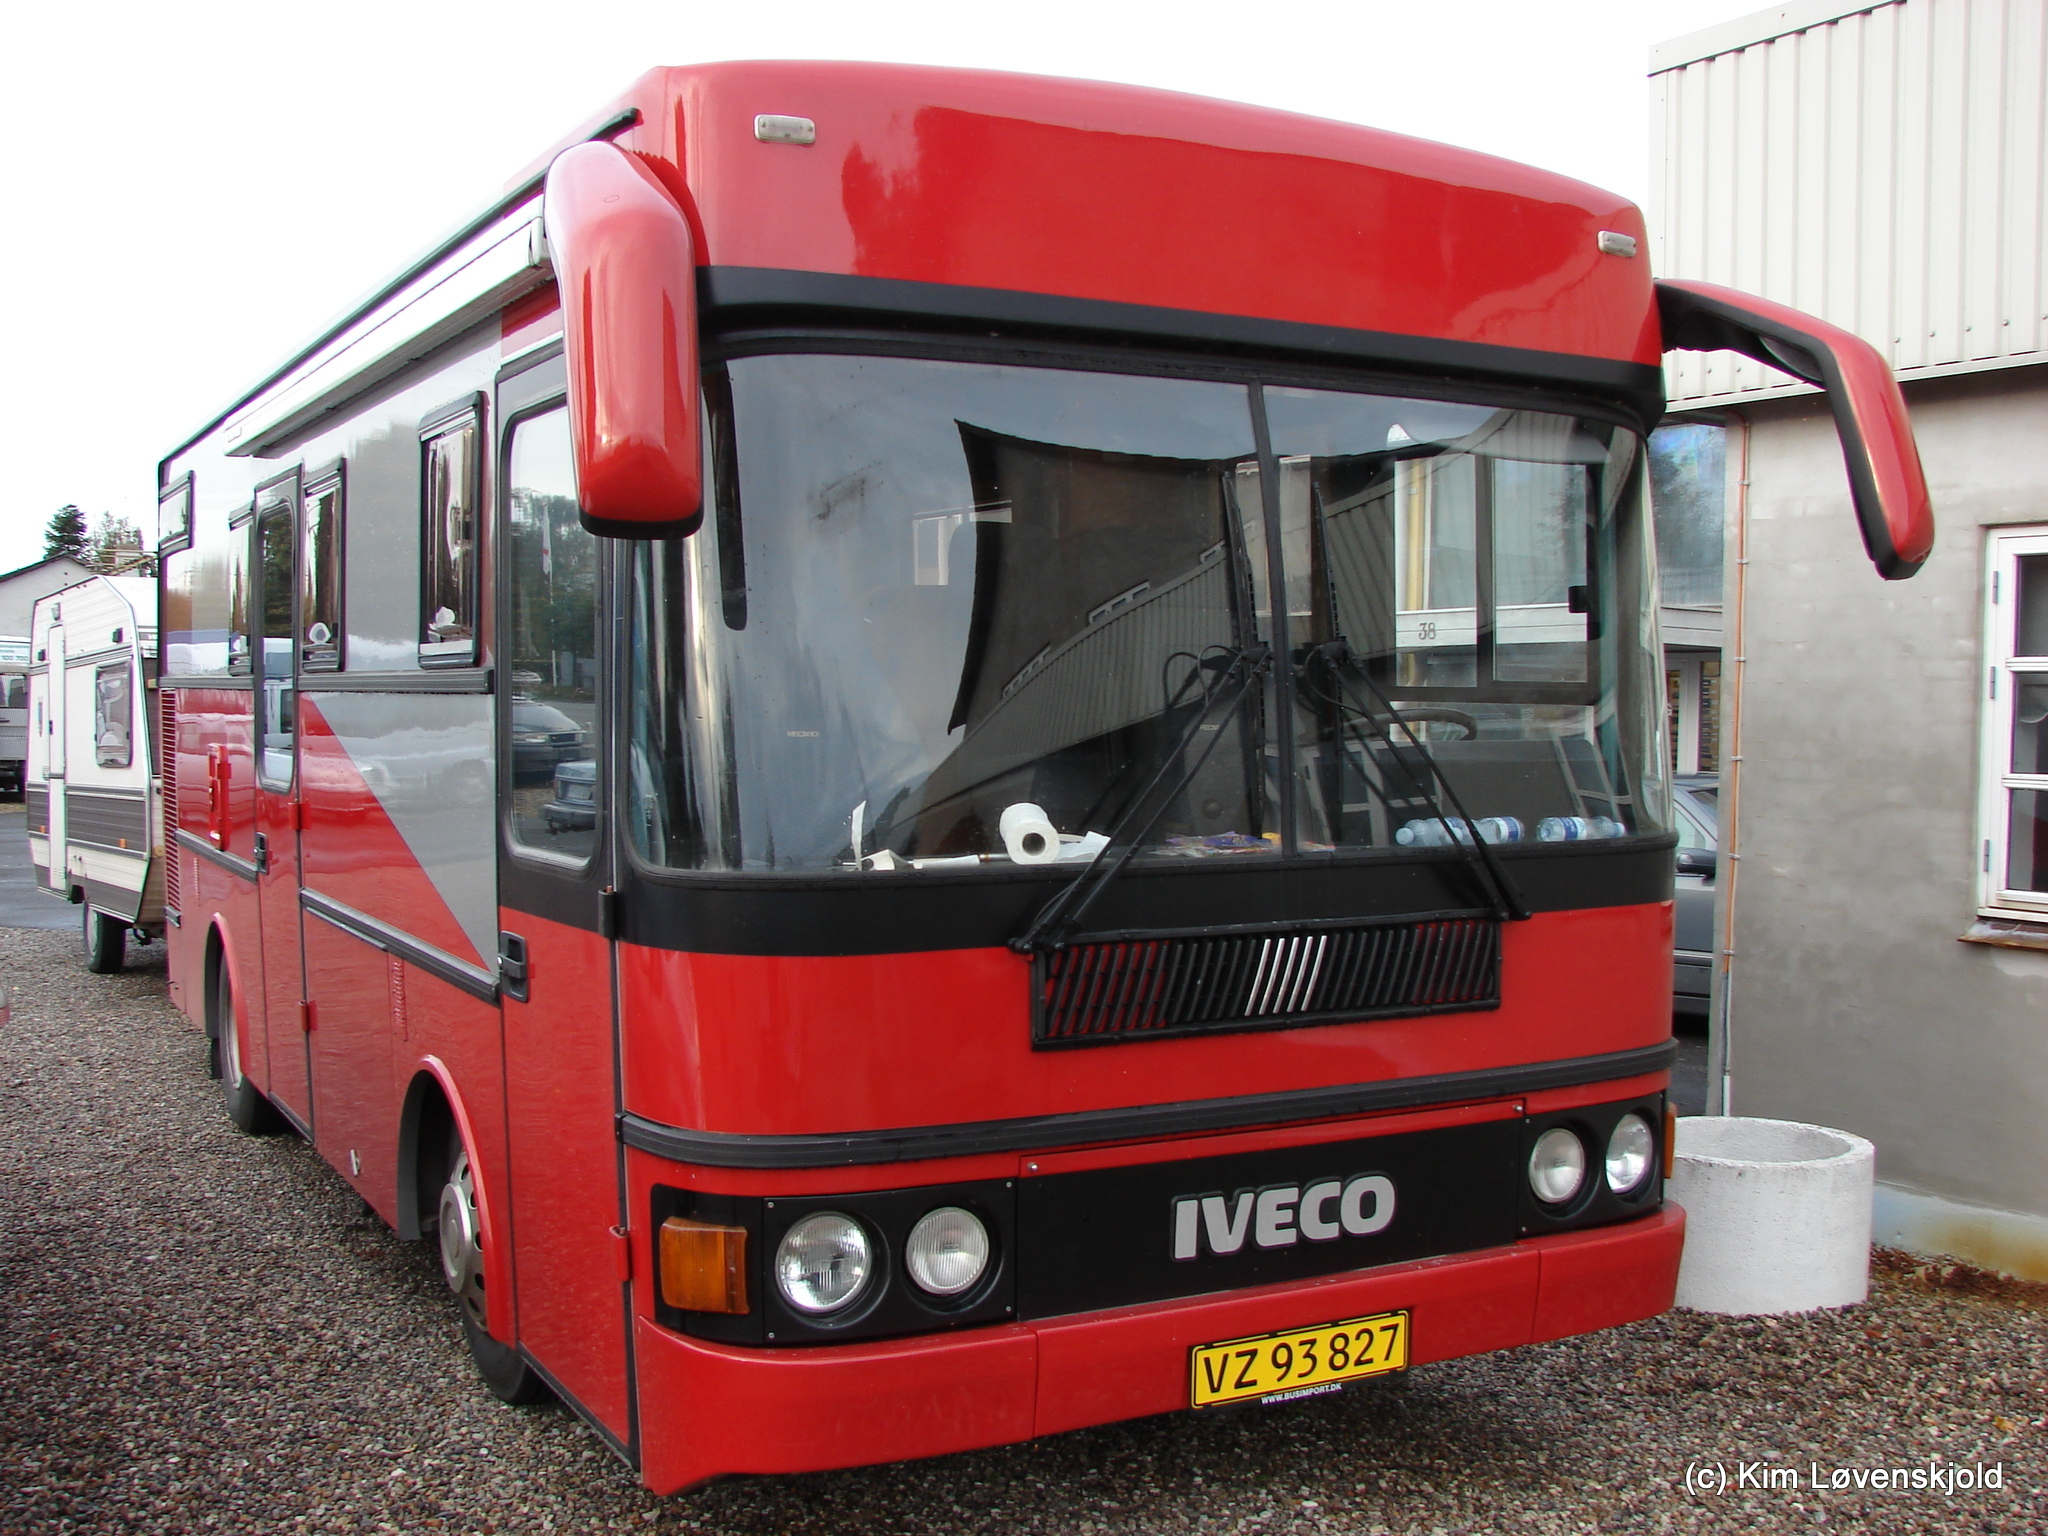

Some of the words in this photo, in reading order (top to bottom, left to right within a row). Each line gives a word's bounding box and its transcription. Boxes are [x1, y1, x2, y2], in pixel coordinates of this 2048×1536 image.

[1418, 622, 1436, 640] 38
[1173, 1175, 1396, 1260] IVECO
[1203, 1347, 1258, 1394] VZ
[1271, 1337, 1317, 1383] 93
[1328, 1322, 1400, 1371] 827
[1261, 1382, 1342, 1405] WWW.BUSIMPORT.DK
